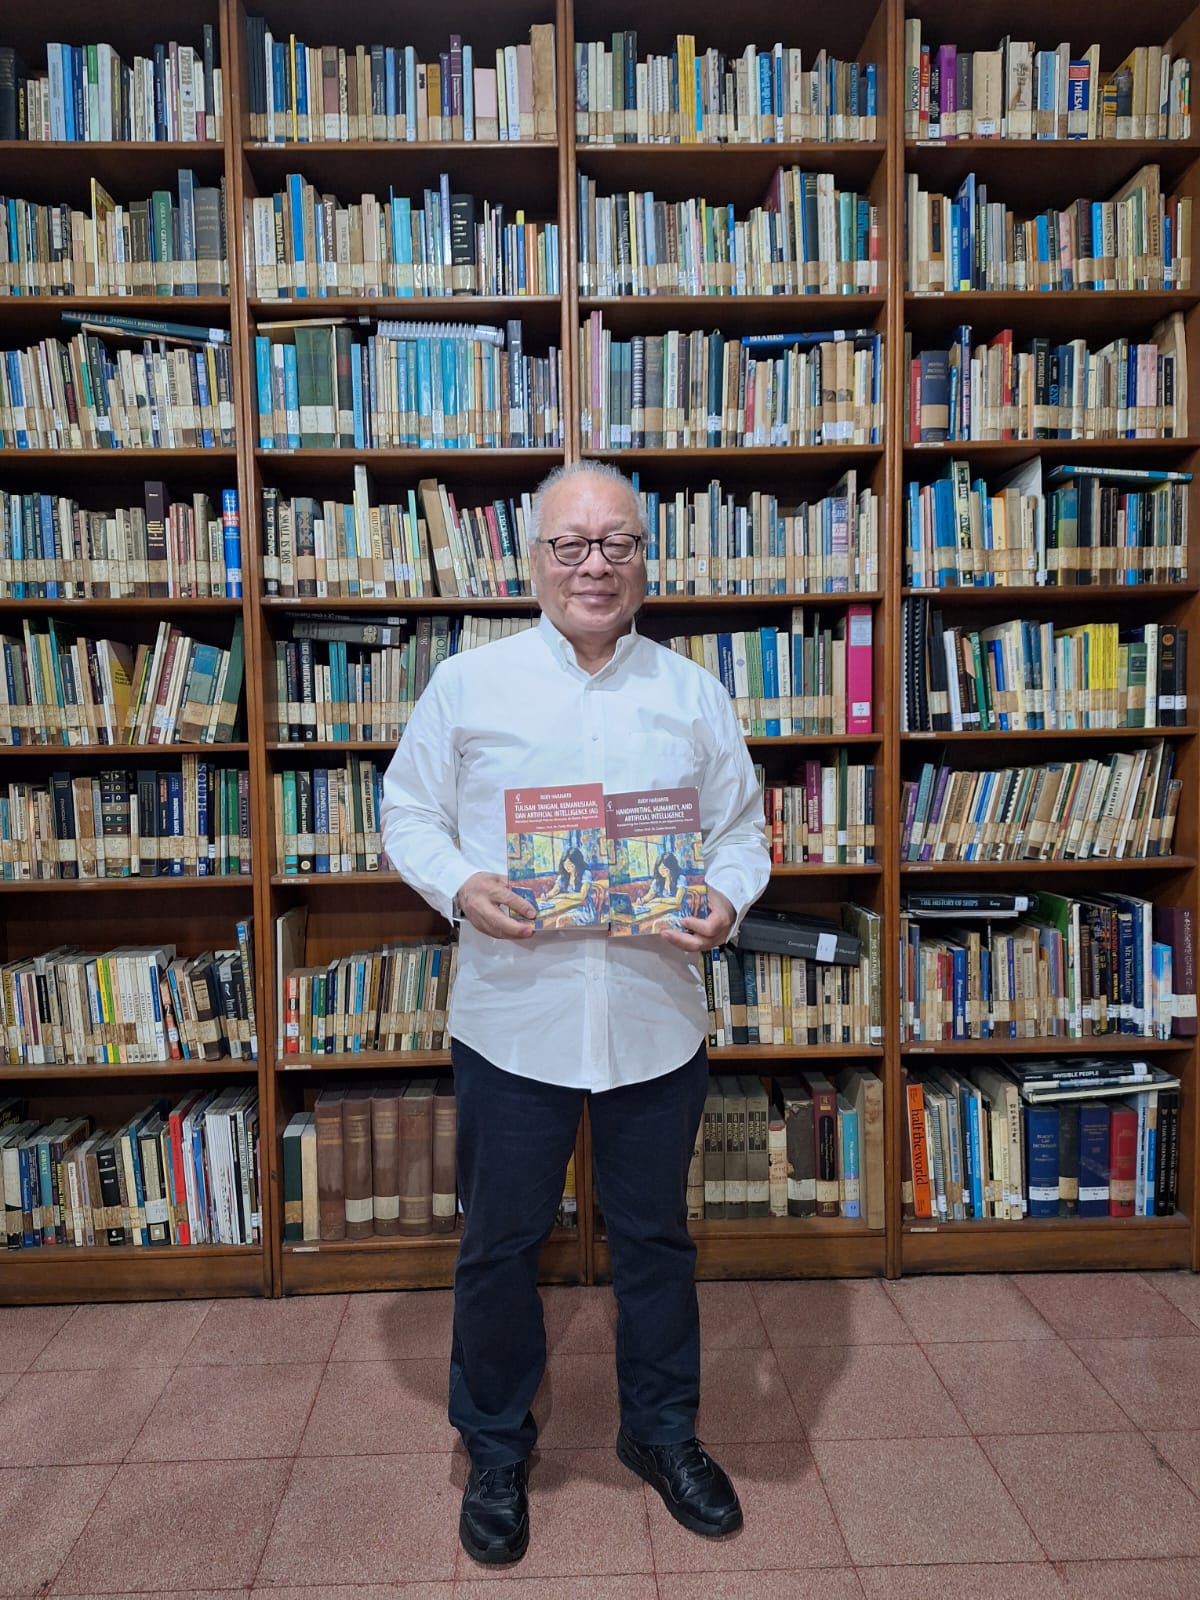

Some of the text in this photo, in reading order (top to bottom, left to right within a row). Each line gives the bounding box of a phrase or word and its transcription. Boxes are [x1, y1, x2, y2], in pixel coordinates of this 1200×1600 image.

[911, 66, 919, 110] ASTRONOM
[749, 333, 784, 344] SHARKS
[1038, 352, 1046, 388] PSYCHOLOGY
[280, 514, 289, 538] SMALL
[371, 511, 380, 536] CULTURE
[281, 550, 290, 564] POS
[198, 765, 207, 812] SOUTH
[515, 804, 535, 812] TULISAN
[515, 812, 526, 820] DAN
[527, 811, 553, 819] ARTIFICIAL
[554, 809, 588, 817] INTELLIGENCE
[616, 806, 652, 816] HANDWRITING,
[625, 812, 684, 822] ARTIFICIAL INTELLIGENCE
[932, 899, 953, 907] HISTORY
[954, 899, 962, 907] OF
[1124, 959, 1132, 993] President
[706, 974, 714, 1010] POSTMODERN
[1052, 1070, 1099, 1080] INVISIBLE PEOPLE
[911, 1108, 928, 1185] half the world
